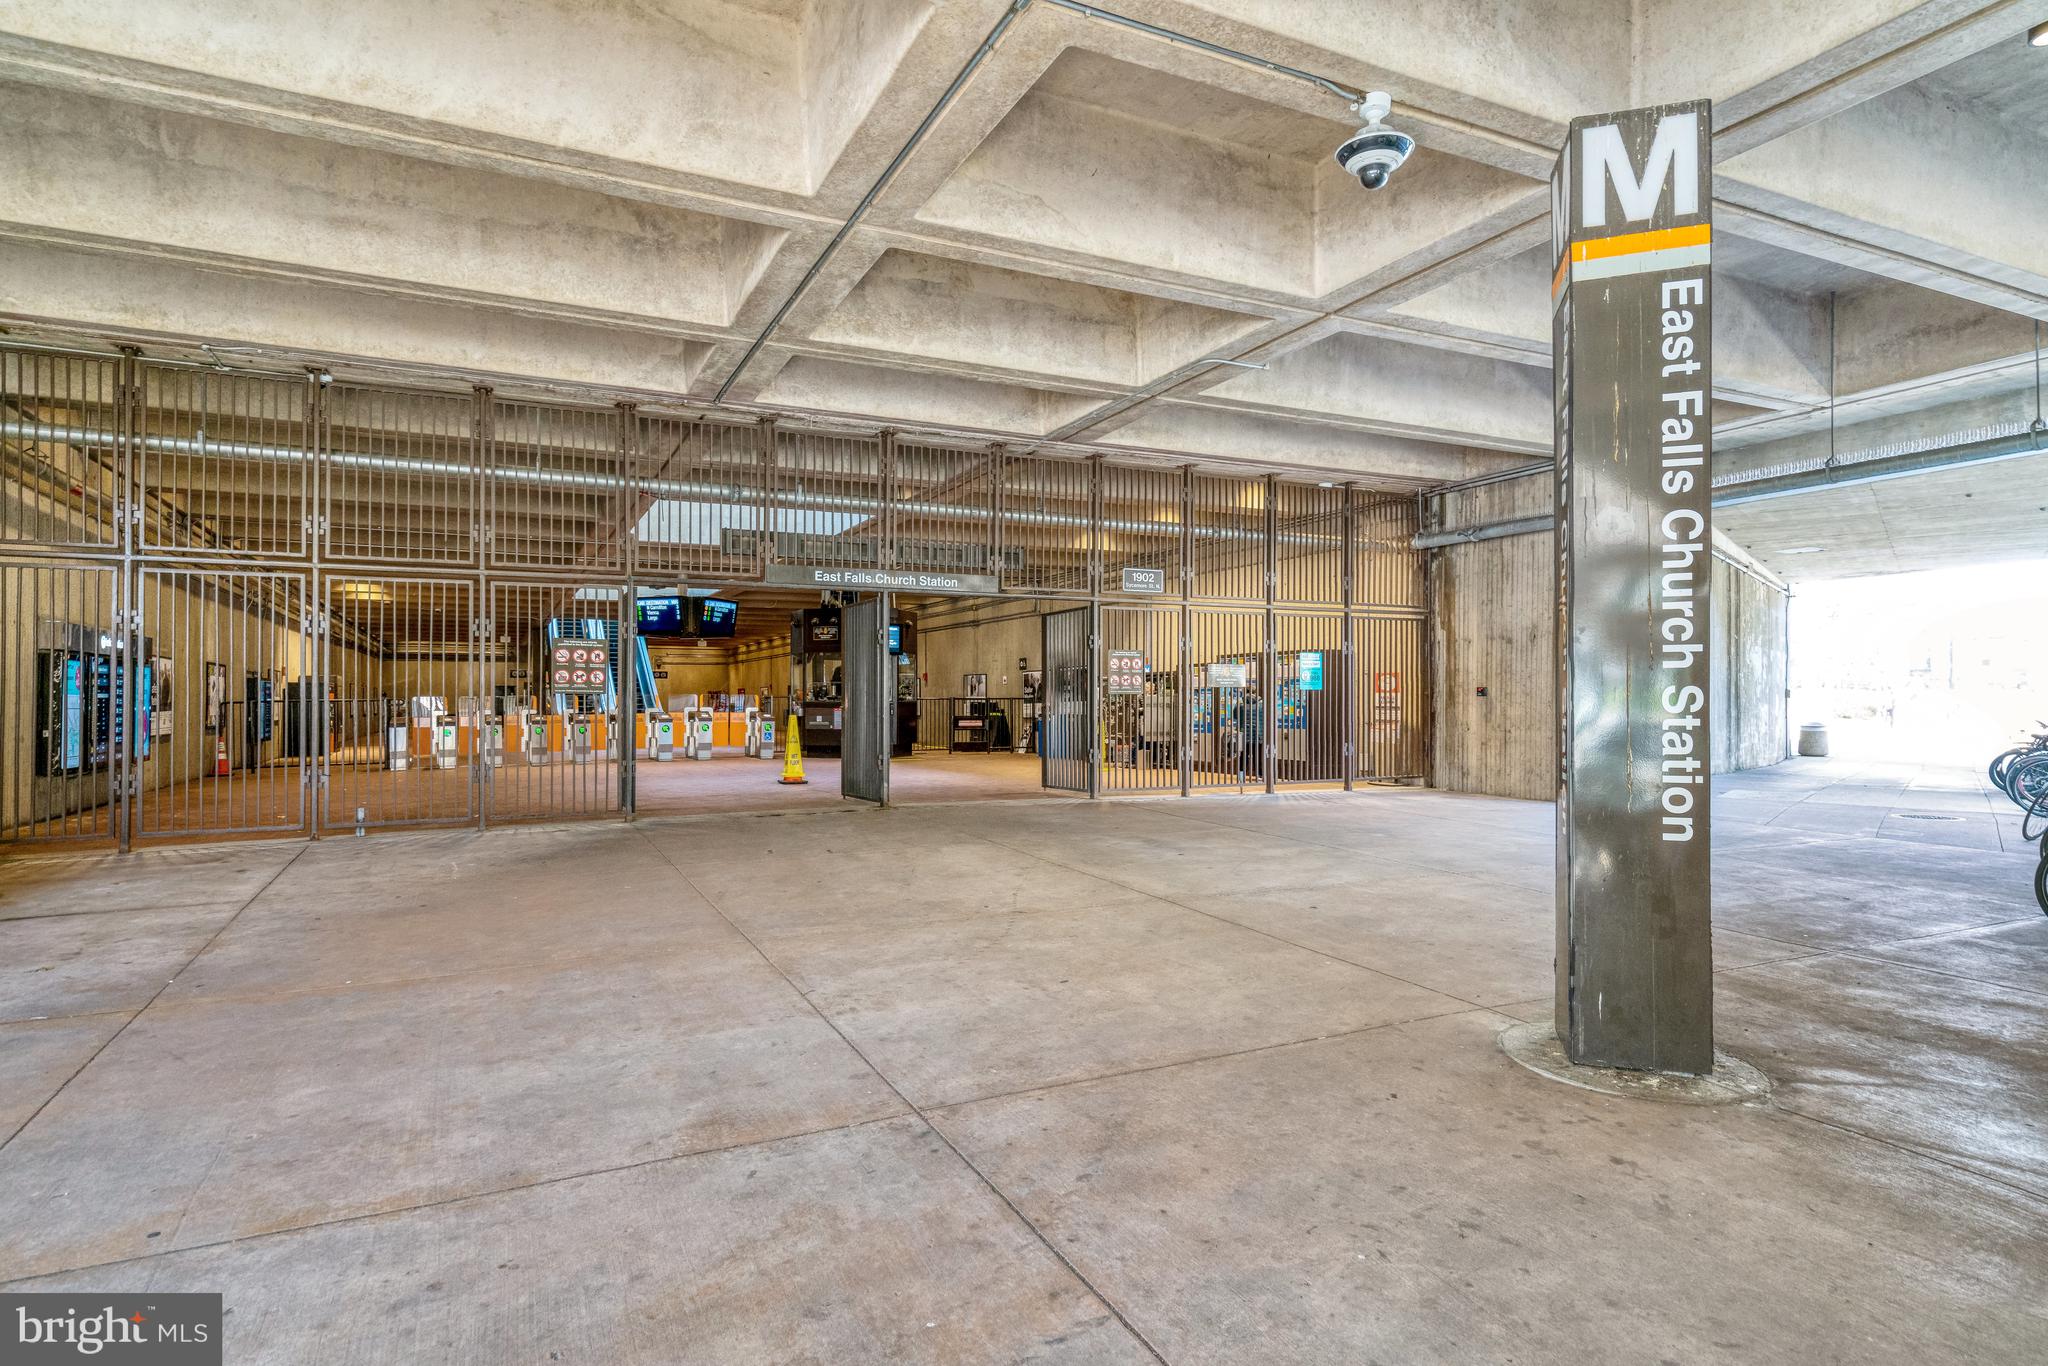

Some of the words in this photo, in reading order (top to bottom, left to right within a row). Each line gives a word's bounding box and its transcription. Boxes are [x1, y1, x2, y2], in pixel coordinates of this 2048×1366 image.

[1582, 112, 1698, 228] M
[1661, 279, 1704, 378] East
[1661, 390, 1704, 495] Falls
[814, 570, 841, 582] East
[844, 572, 872, 584] Falls
[875, 573, 916, 586] Church
[919, 575, 958, 588] Station
[1132, 572, 1155, 583] 1902
[1661, 508, 1705, 669] Church
[1661, 684, 1705, 842] Station
